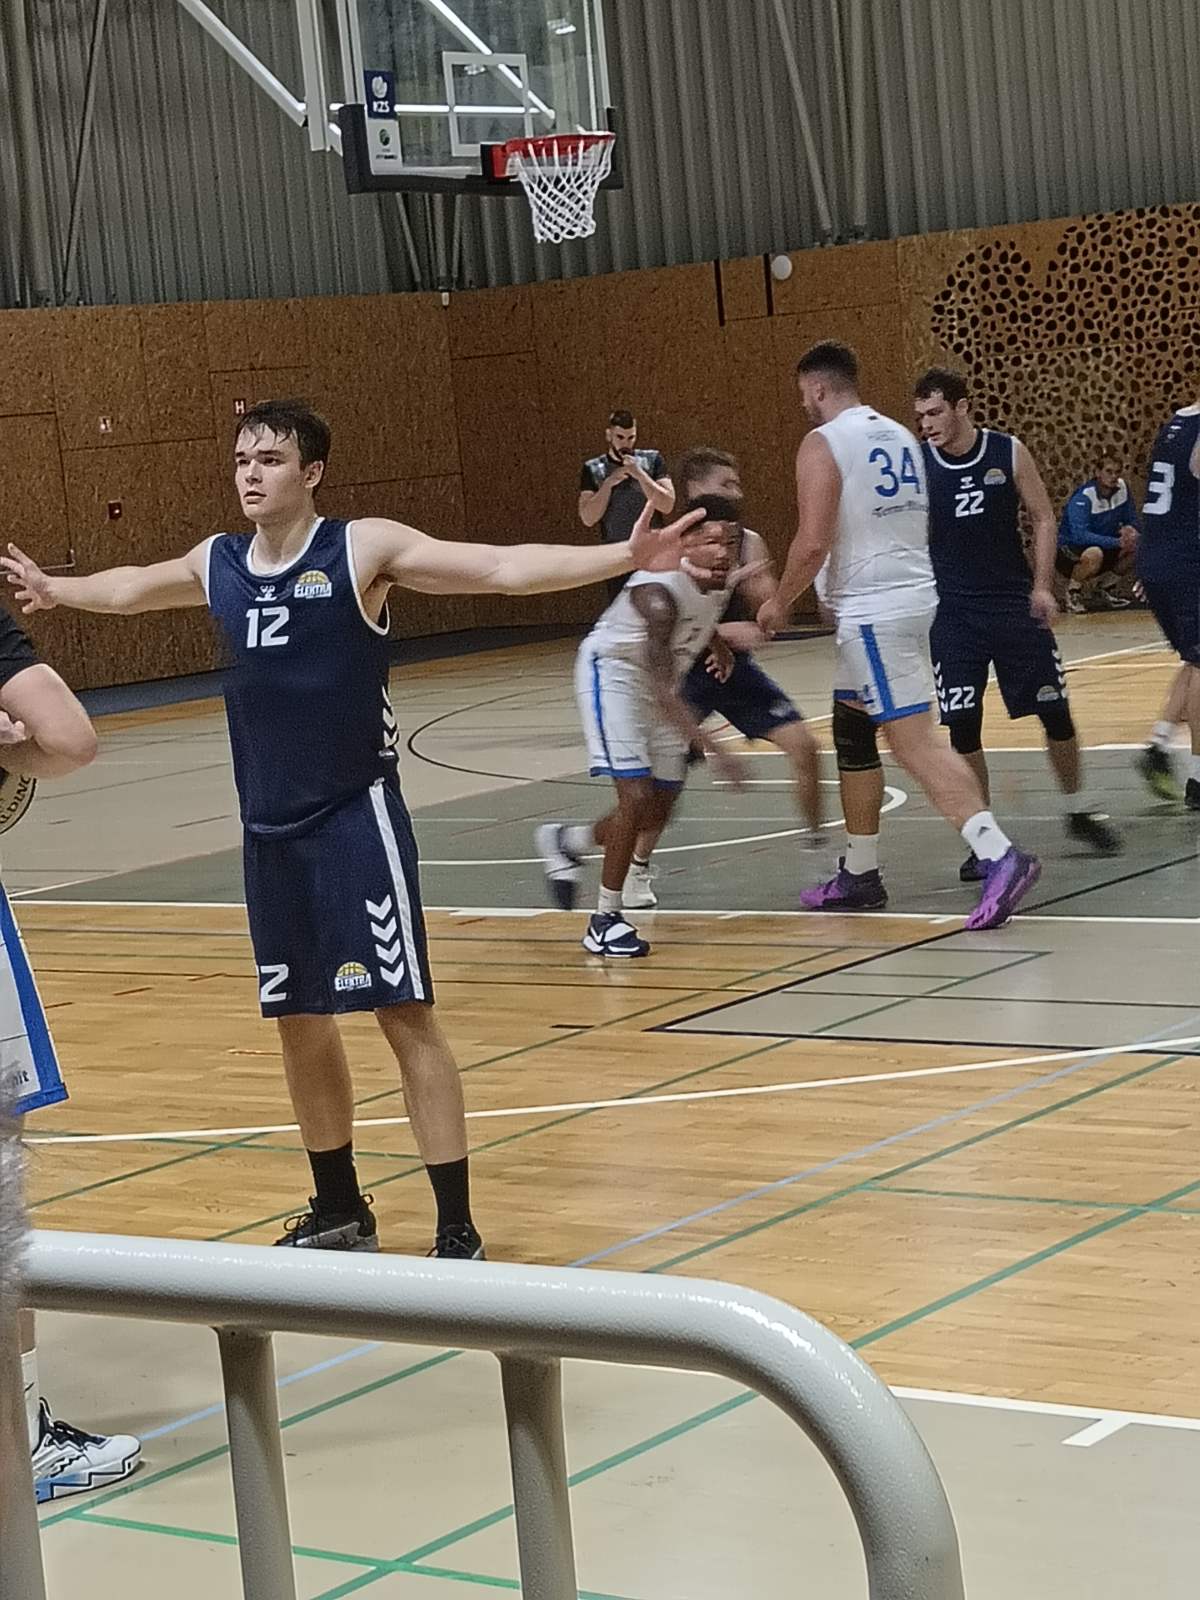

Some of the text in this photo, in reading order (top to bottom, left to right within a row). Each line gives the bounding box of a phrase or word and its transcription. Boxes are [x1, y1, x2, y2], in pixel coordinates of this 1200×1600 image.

[869, 447, 921, 497] 34
[1142, 461, 1175, 515] 3
[954, 490, 985, 518] 22
[245, 606, 290, 649] 12
[949, 686, 976, 711] 22
